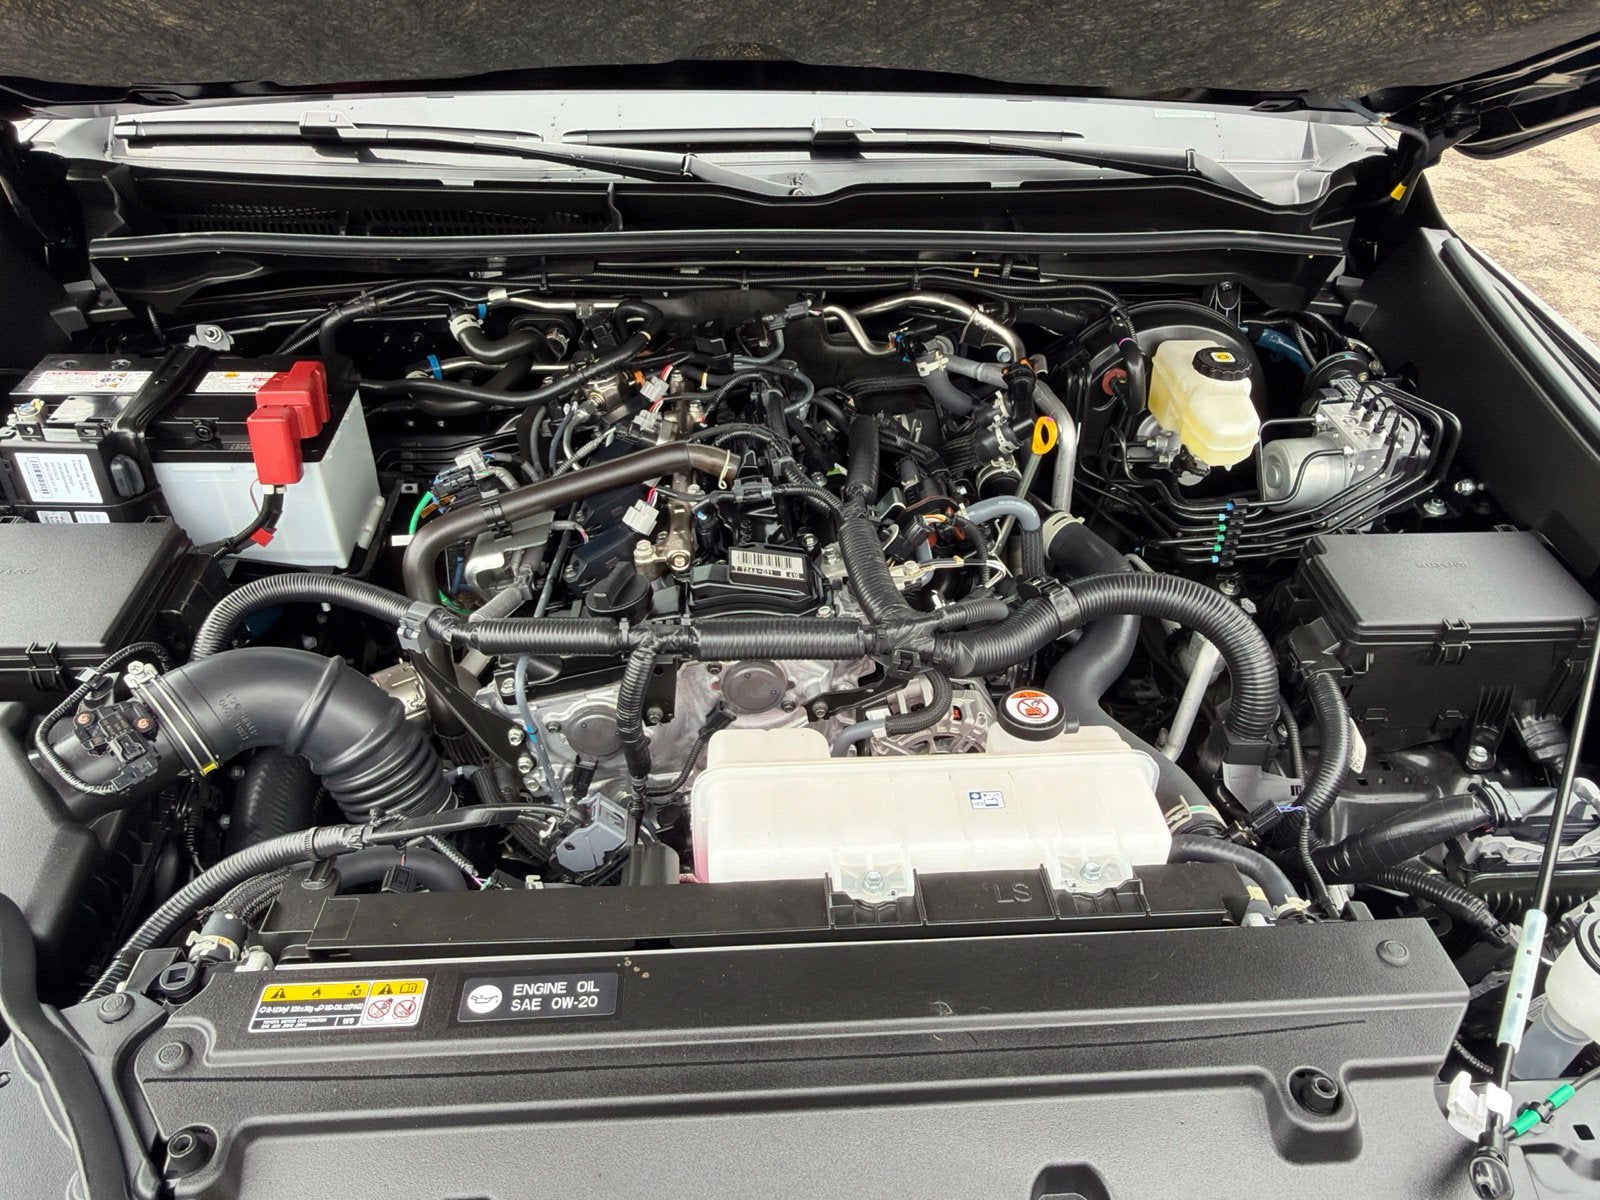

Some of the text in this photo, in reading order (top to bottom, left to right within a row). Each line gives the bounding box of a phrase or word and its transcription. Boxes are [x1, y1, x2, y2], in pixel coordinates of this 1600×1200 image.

[992, 881, 1033, 903] LS
[513, 980, 600, 995] ENGINE OIL
[510, 995, 598, 1011] SAE 0W-20
